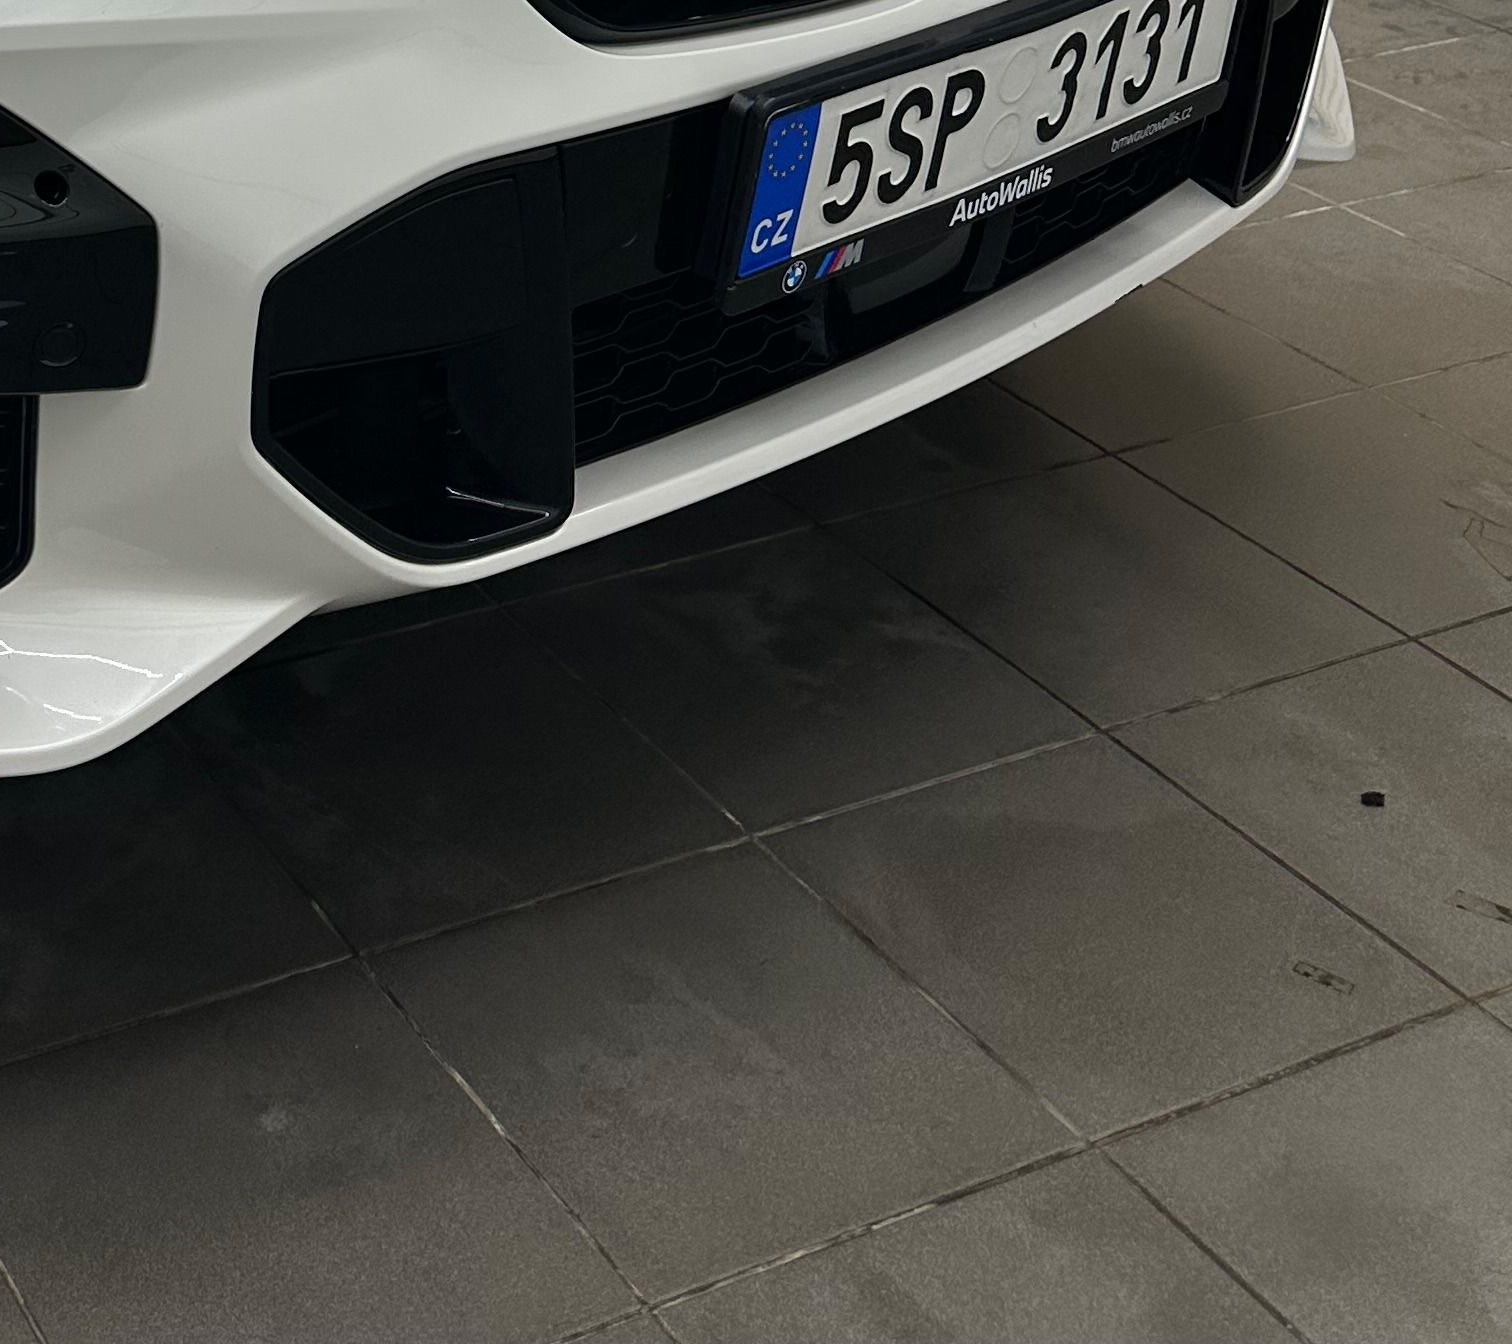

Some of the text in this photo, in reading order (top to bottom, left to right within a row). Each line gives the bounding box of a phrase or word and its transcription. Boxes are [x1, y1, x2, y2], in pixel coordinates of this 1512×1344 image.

[821, 68, 986, 225] 5SP
[948, 164, 1054, 227] AutoWallis
[751, 209, 794, 254] CZ
